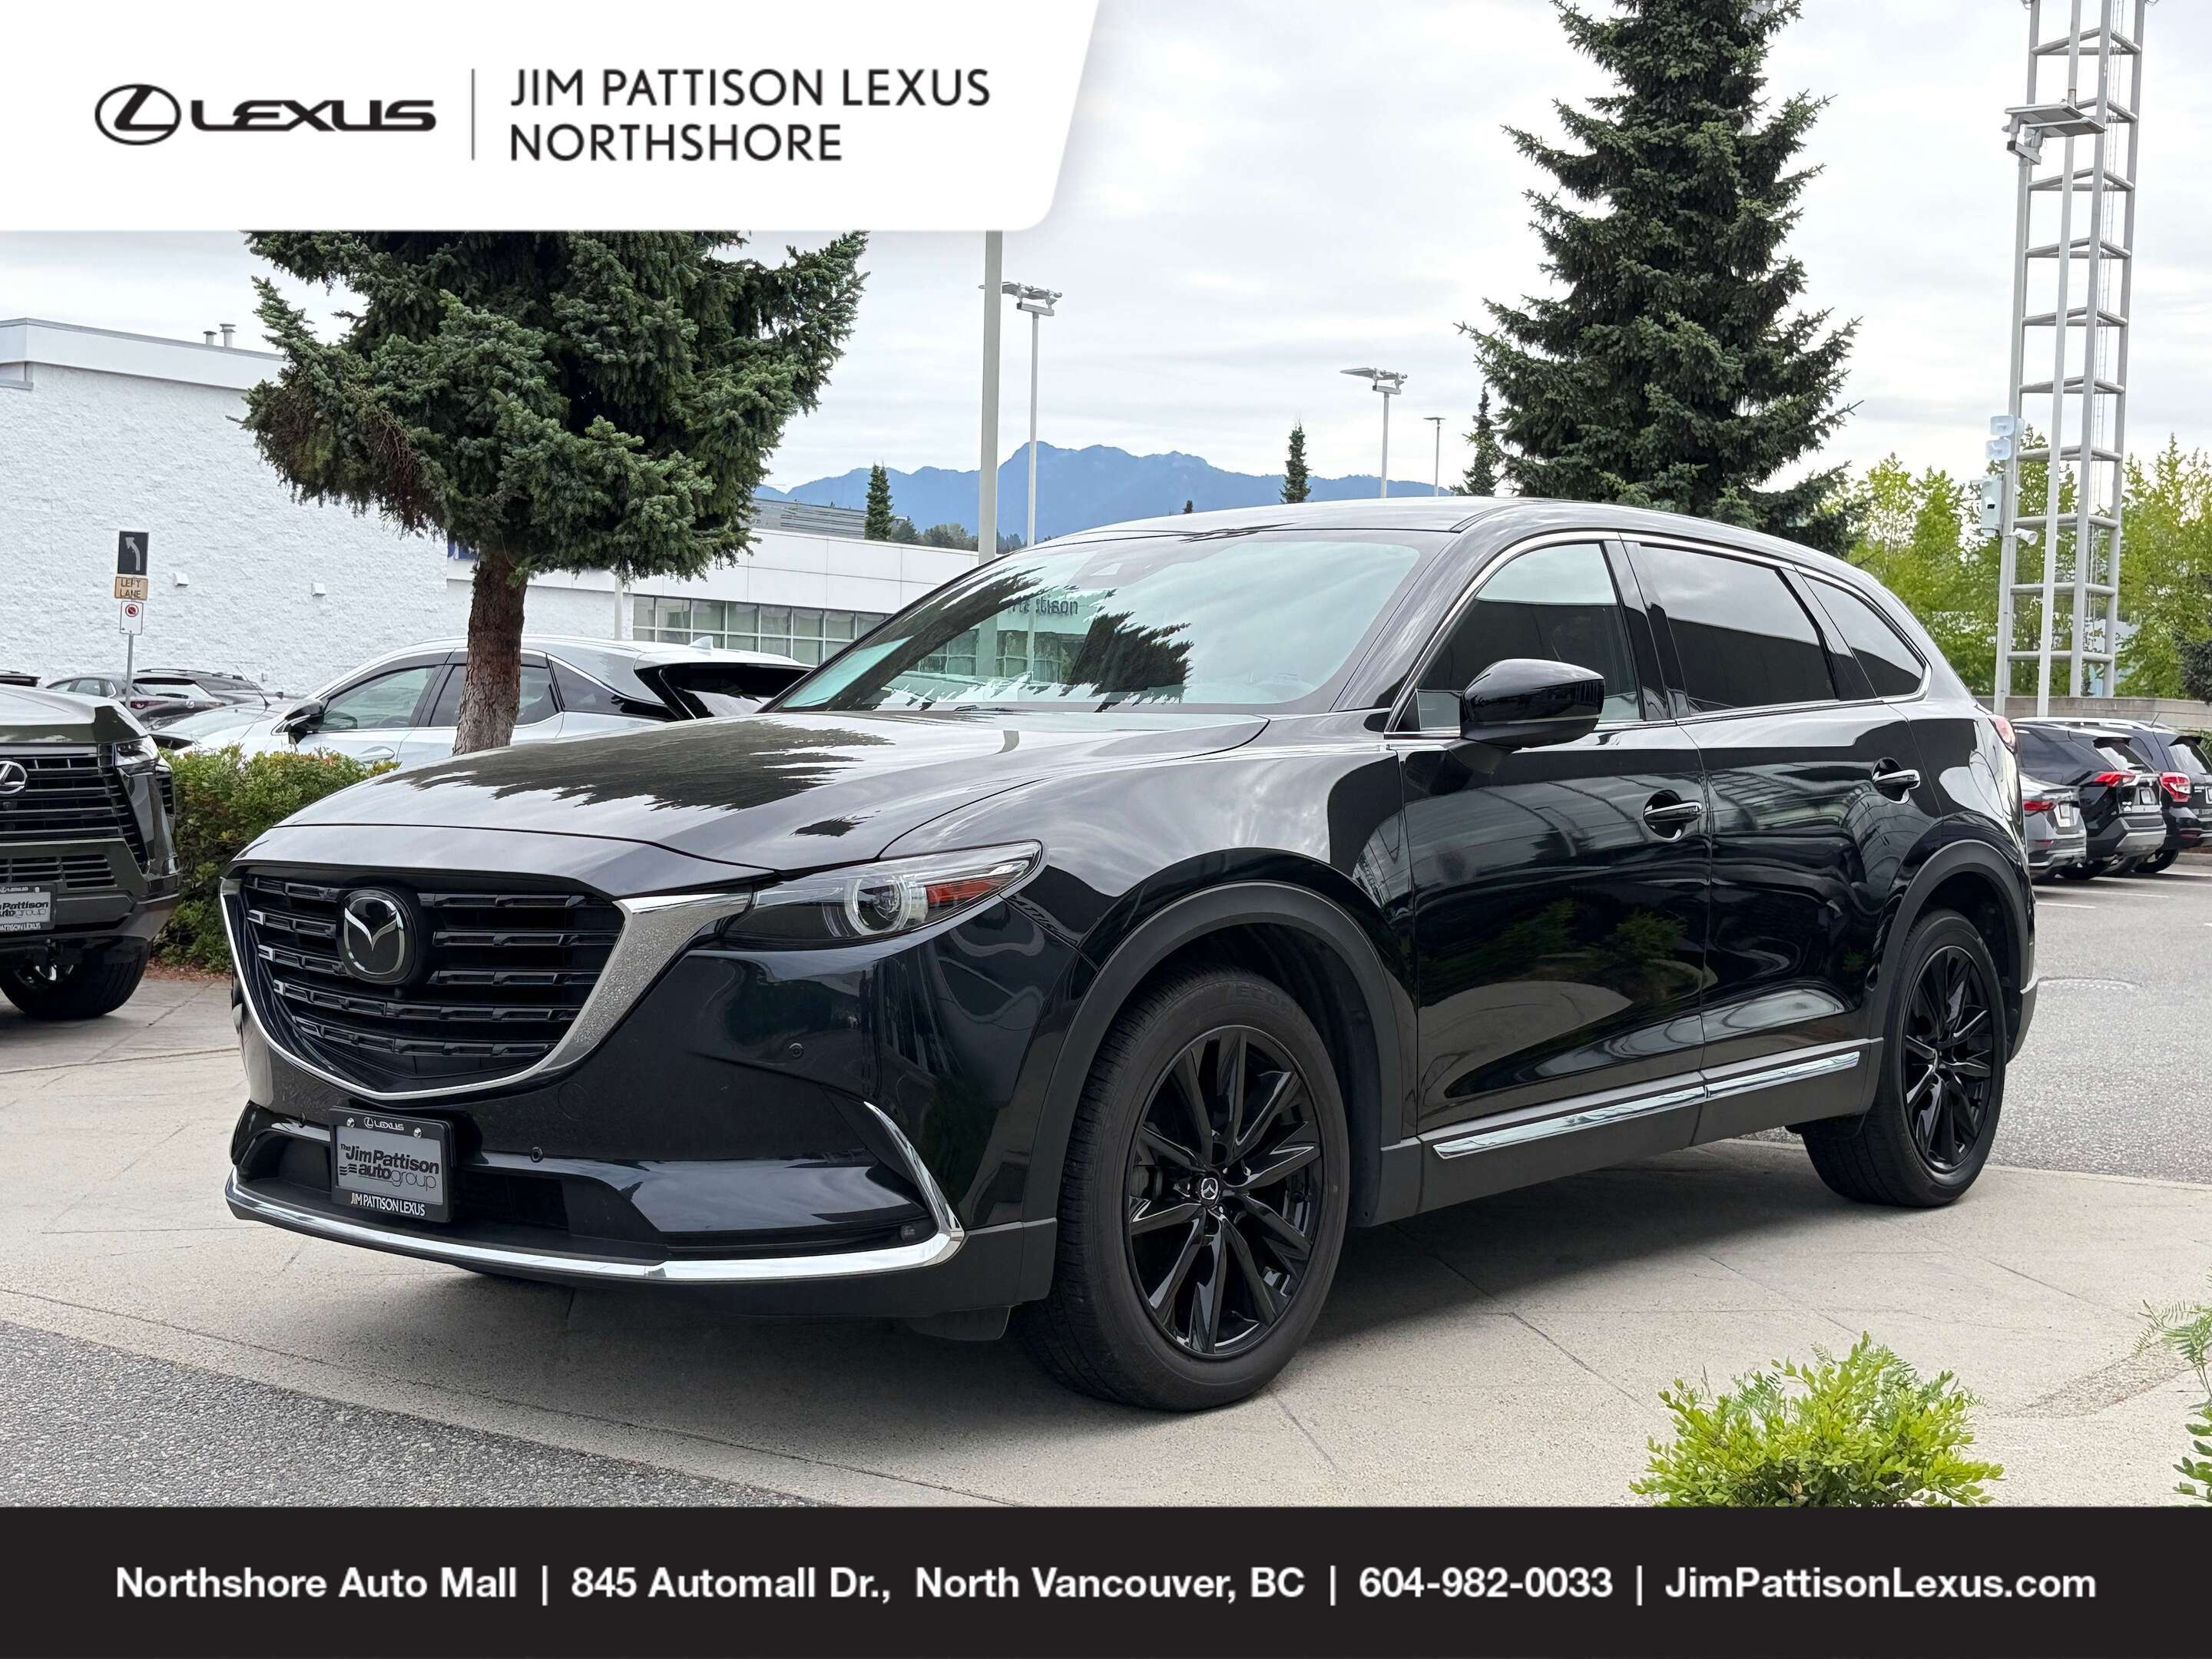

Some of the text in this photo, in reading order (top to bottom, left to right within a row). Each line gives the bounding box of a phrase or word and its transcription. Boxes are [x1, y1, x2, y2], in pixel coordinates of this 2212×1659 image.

[350, 1192, 426, 1217] JIM PATTISON LEXUS
